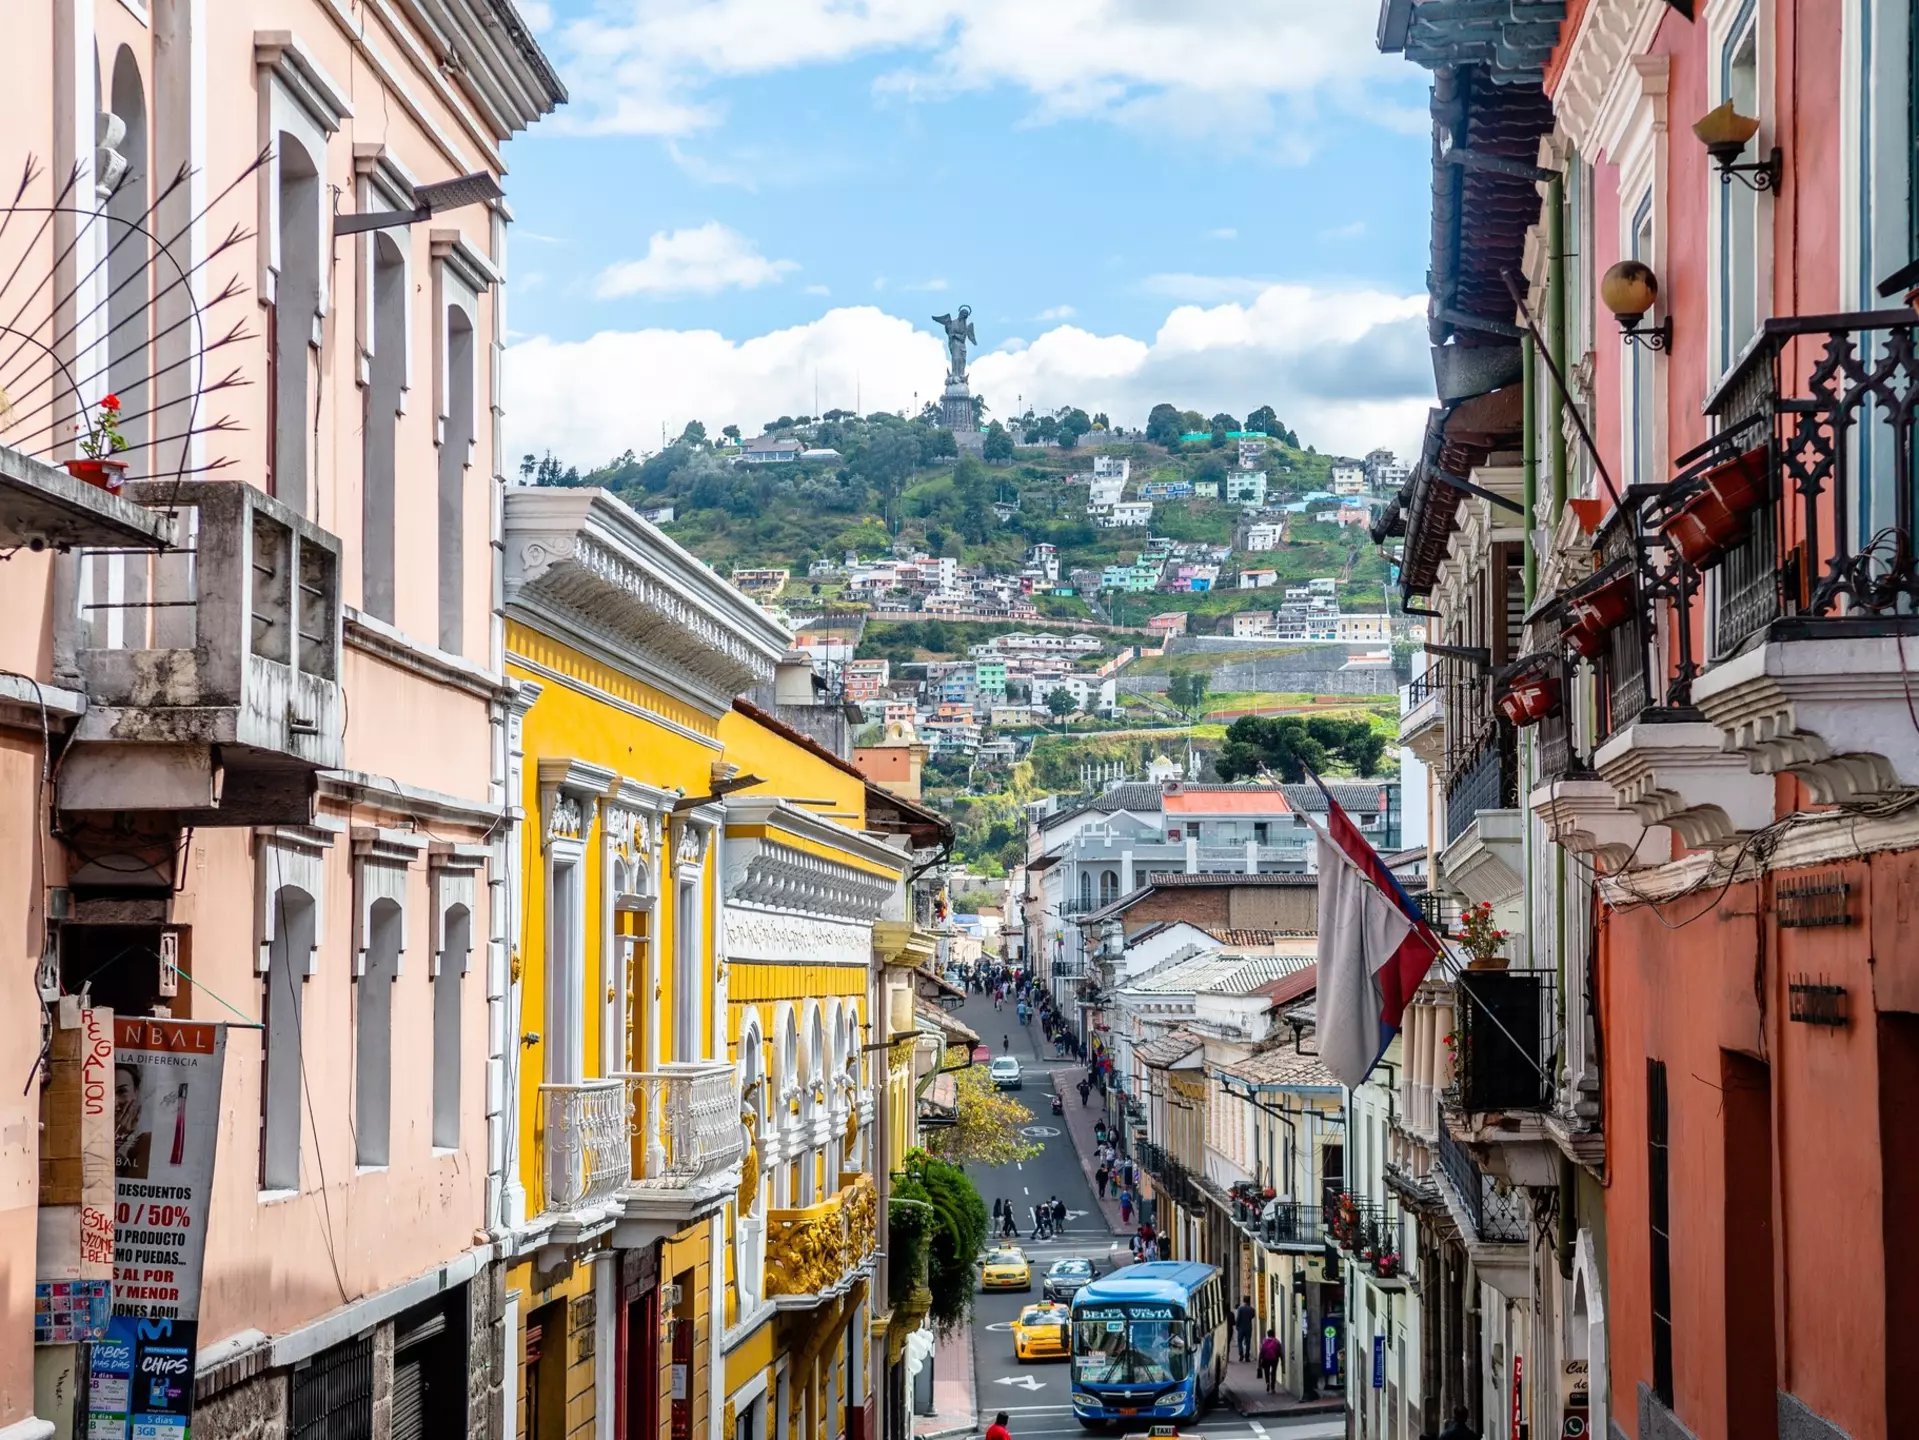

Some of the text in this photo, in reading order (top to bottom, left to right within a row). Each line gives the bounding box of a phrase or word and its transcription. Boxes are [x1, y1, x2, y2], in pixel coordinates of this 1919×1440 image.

[82, 1009, 111, 1115] REGALOS
[121, 1055, 198, 1067] LA DIFERENCIA
[118, 1183, 192, 1200] DESCUENTOS
[114, 1202, 130, 1224] 0
[148, 1204, 191, 1228] 50%
[125, 1229, 186, 1246] PRODUCTO
[123, 1268, 140, 1282] AL
[143, 1269, 175, 1283] POR
[114, 1284, 179, 1301] Y MENOR
[1082, 1308, 1173, 1319] BELLA VISTA
[1573, 1378, 1588, 1389] de
[147, 1415, 153, 1423] 5
[136, 1426, 156, 1437] 3GB
[1156, 1427, 1172, 1435] TAXI
